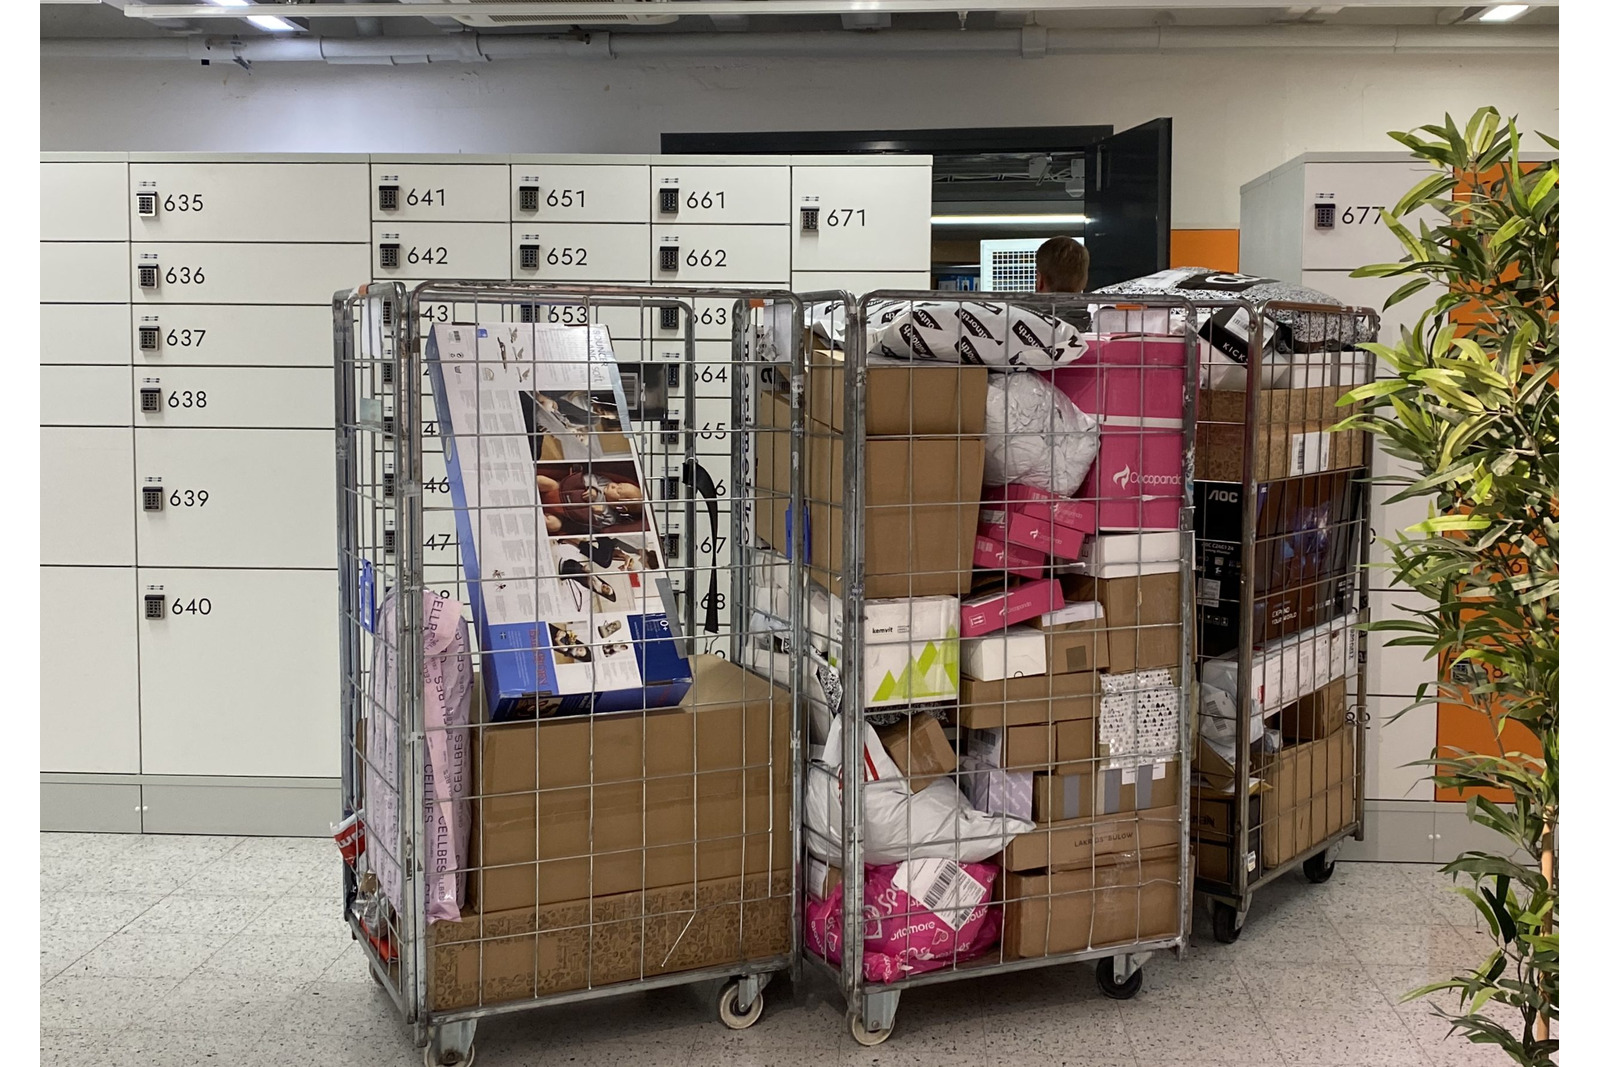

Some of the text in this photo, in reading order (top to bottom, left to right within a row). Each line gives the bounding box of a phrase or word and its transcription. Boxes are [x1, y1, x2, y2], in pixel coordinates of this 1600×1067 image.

[164, 194, 204, 212] 635
[407, 188, 446, 206] 641
[547, 190, 585, 208] 651
[686, 191, 725, 209] 661
[826, 209, 866, 227] 671
[1342, 206, 1385, 224] 677
[407, 247, 448, 265] 642
[547, 248, 587, 266] 652
[686, 249, 726, 267] 662
[166, 267, 205, 284] 636
[423, 305, 448, 322] 43
[548, 306, 588, 323] 653
[166, 329, 206, 347] 637
[1223, 342, 1248, 362] KICK
[168, 391, 207, 408] 638
[695, 422, 726, 440] 65
[424, 477, 450, 494] 46
[170, 490, 209, 507] 639
[1208, 490, 1238, 503] AOC
[425, 534, 450, 551] 47
[696, 536, 726, 553] 67
[172, 598, 212, 615] 640
[696, 592, 726, 610] 68
[454, 734, 463, 792] CELLBES
[437, 816, 448, 873] CELLBES
[890, 921, 936, 941] ortamore
